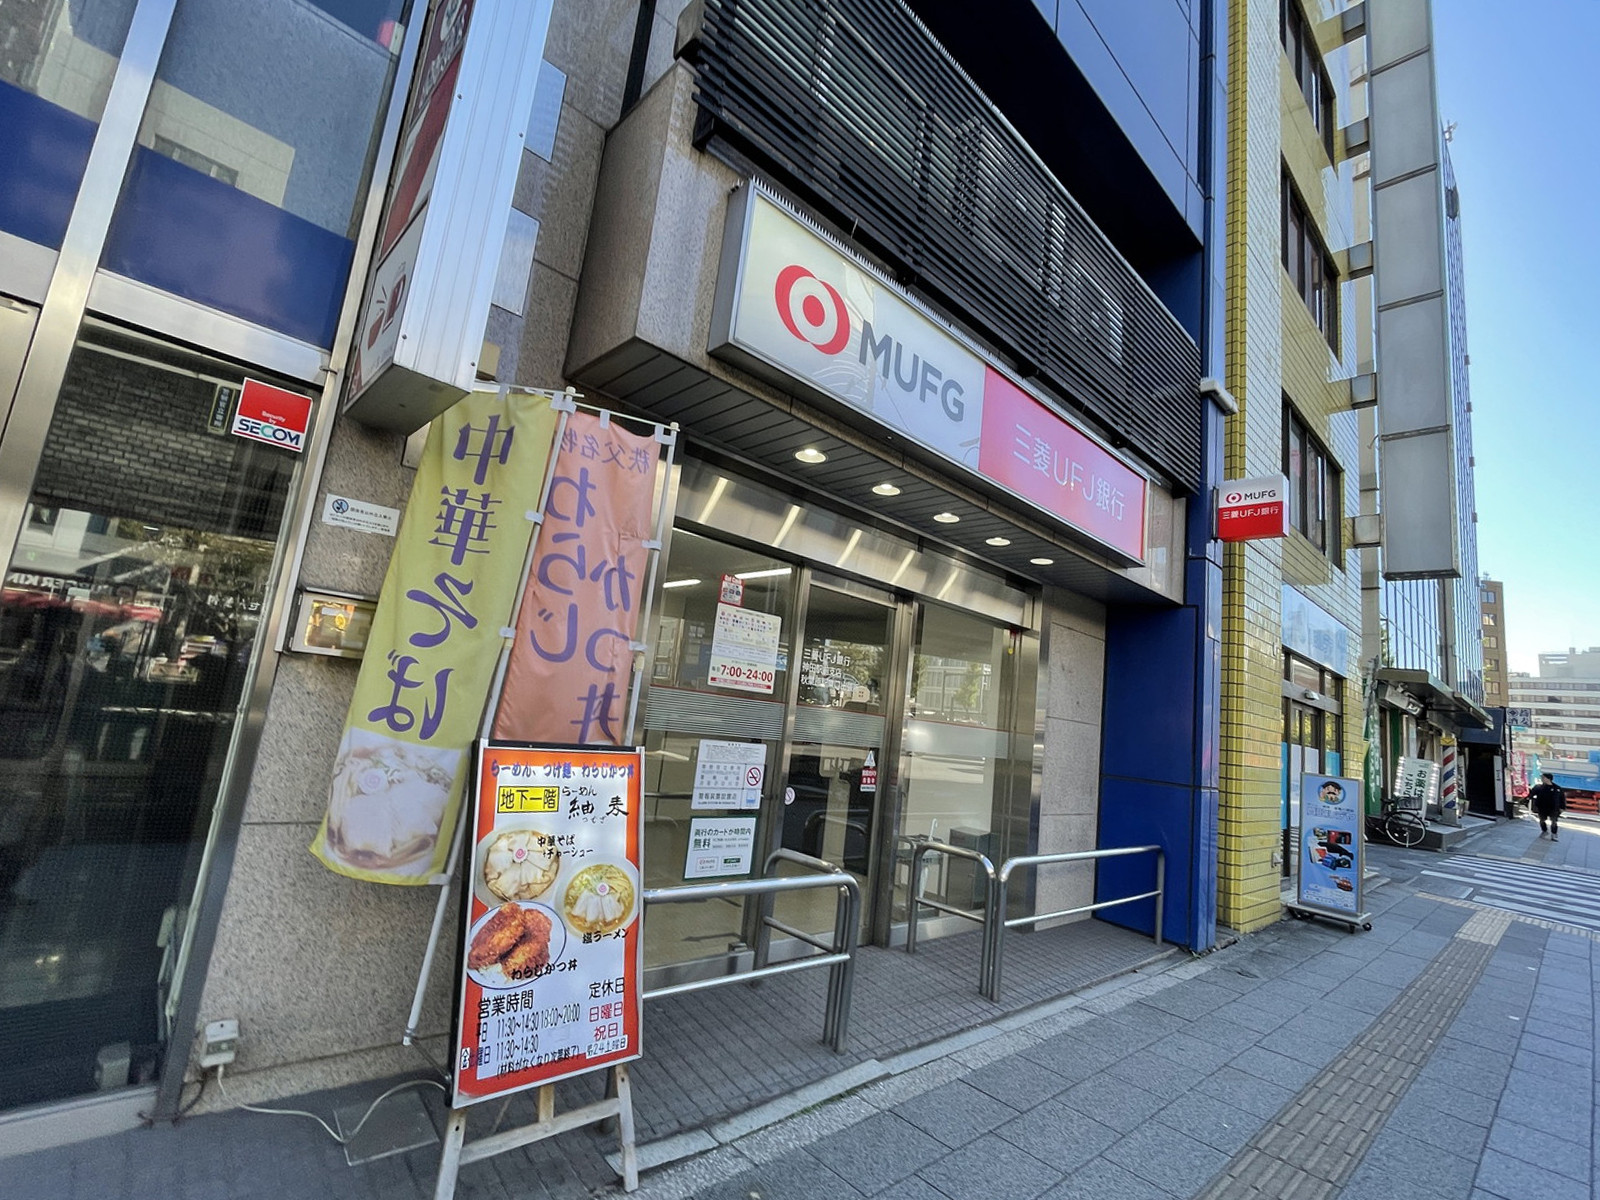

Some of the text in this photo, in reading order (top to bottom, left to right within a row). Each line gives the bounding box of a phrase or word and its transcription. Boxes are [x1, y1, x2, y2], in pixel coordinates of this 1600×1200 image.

[859, 319, 965, 422] MUFG
[238, 418, 300, 445] SECOM
[1013, 423, 1125, 521] 三菱UFJ銀行
[1244, 489, 1276, 500] MUFG
[1222, 505, 1279, 520] 三菱UFJ銀行
[500, 788, 558, 810] 地下一階
[537, 833, 576, 848] 中華そば
[582, 928, 630, 944] 塩ラーメン
[511, 958, 578, 981] わらじかつ丼
[588, 976, 625, 1000] 定休日
[478, 989, 534, 1020] 営業時間
[589, 1001, 624, 1023] 日曜日
[594, 1022, 618, 1042] 祝日
